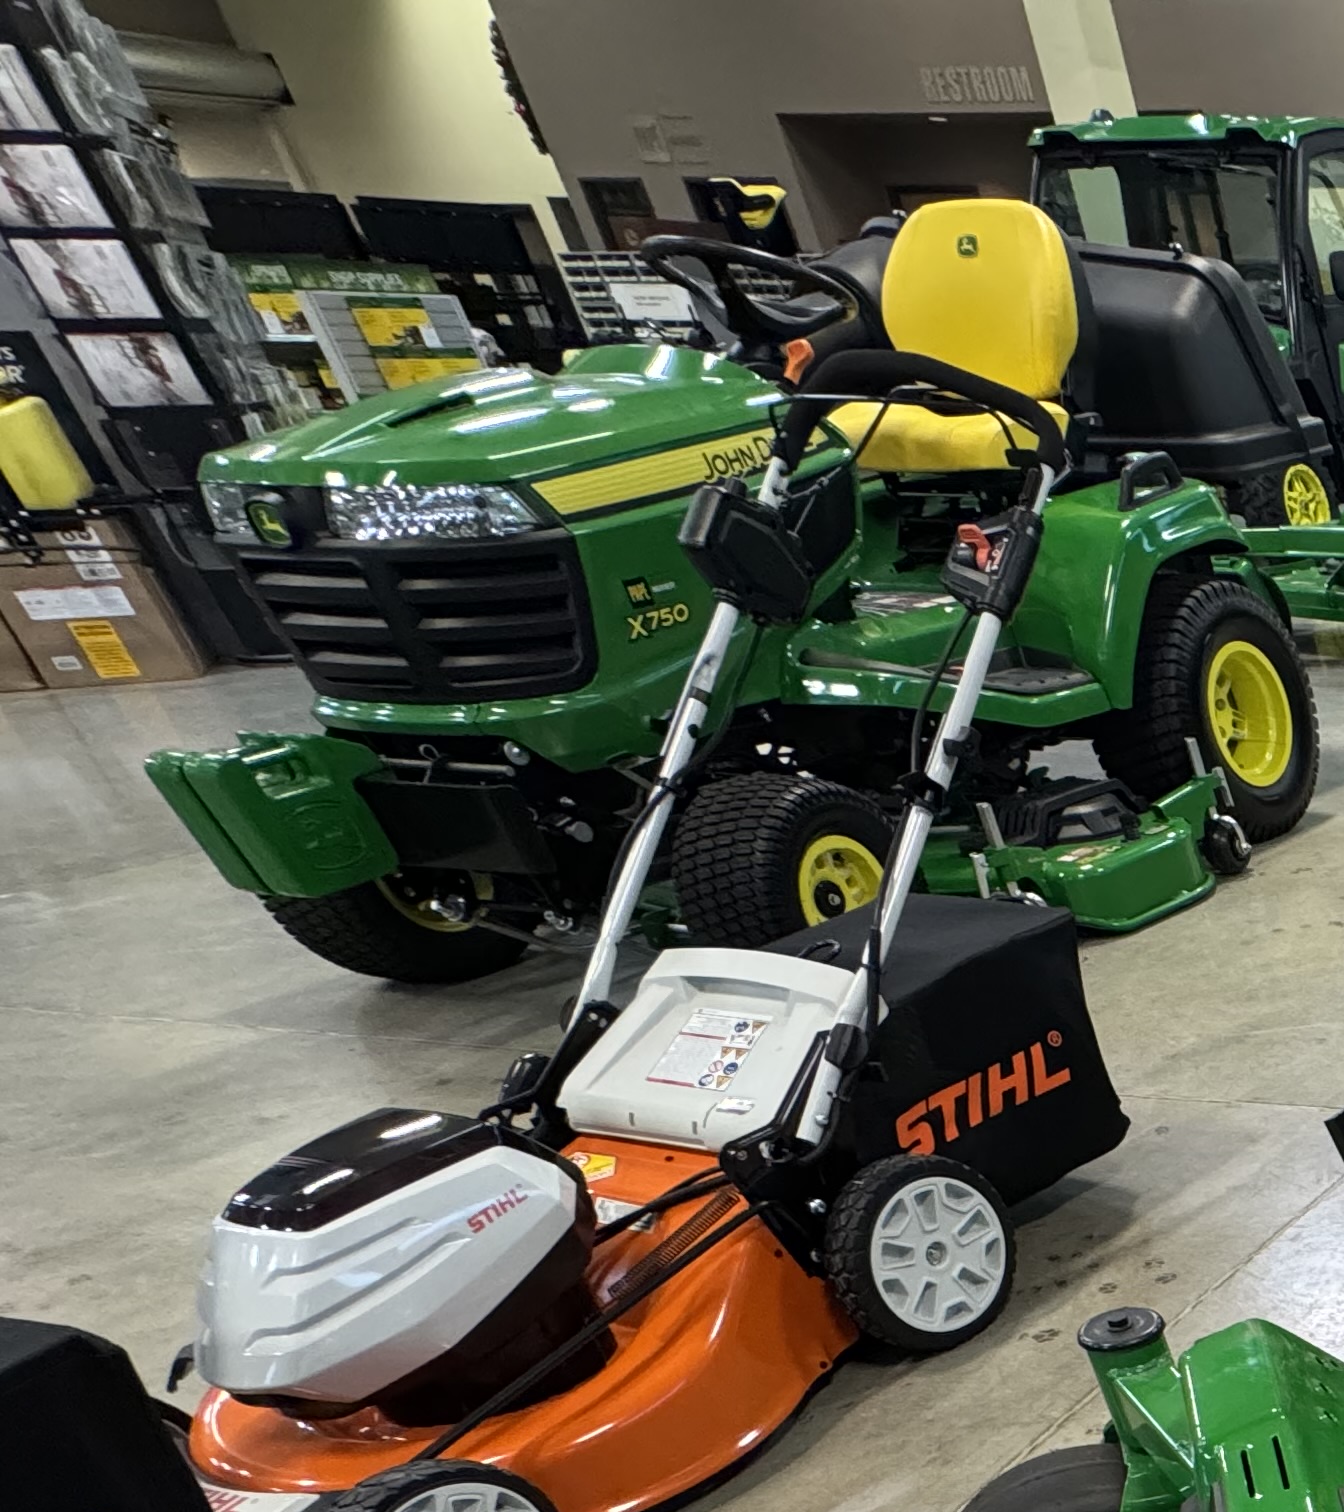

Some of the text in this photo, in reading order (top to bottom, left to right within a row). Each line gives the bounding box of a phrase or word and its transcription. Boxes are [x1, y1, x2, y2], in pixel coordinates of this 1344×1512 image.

[920, 66, 1035, 102] RESTROOM
[702, 446, 752, 480] JOHN
[627, 603, 689, 640] X750
